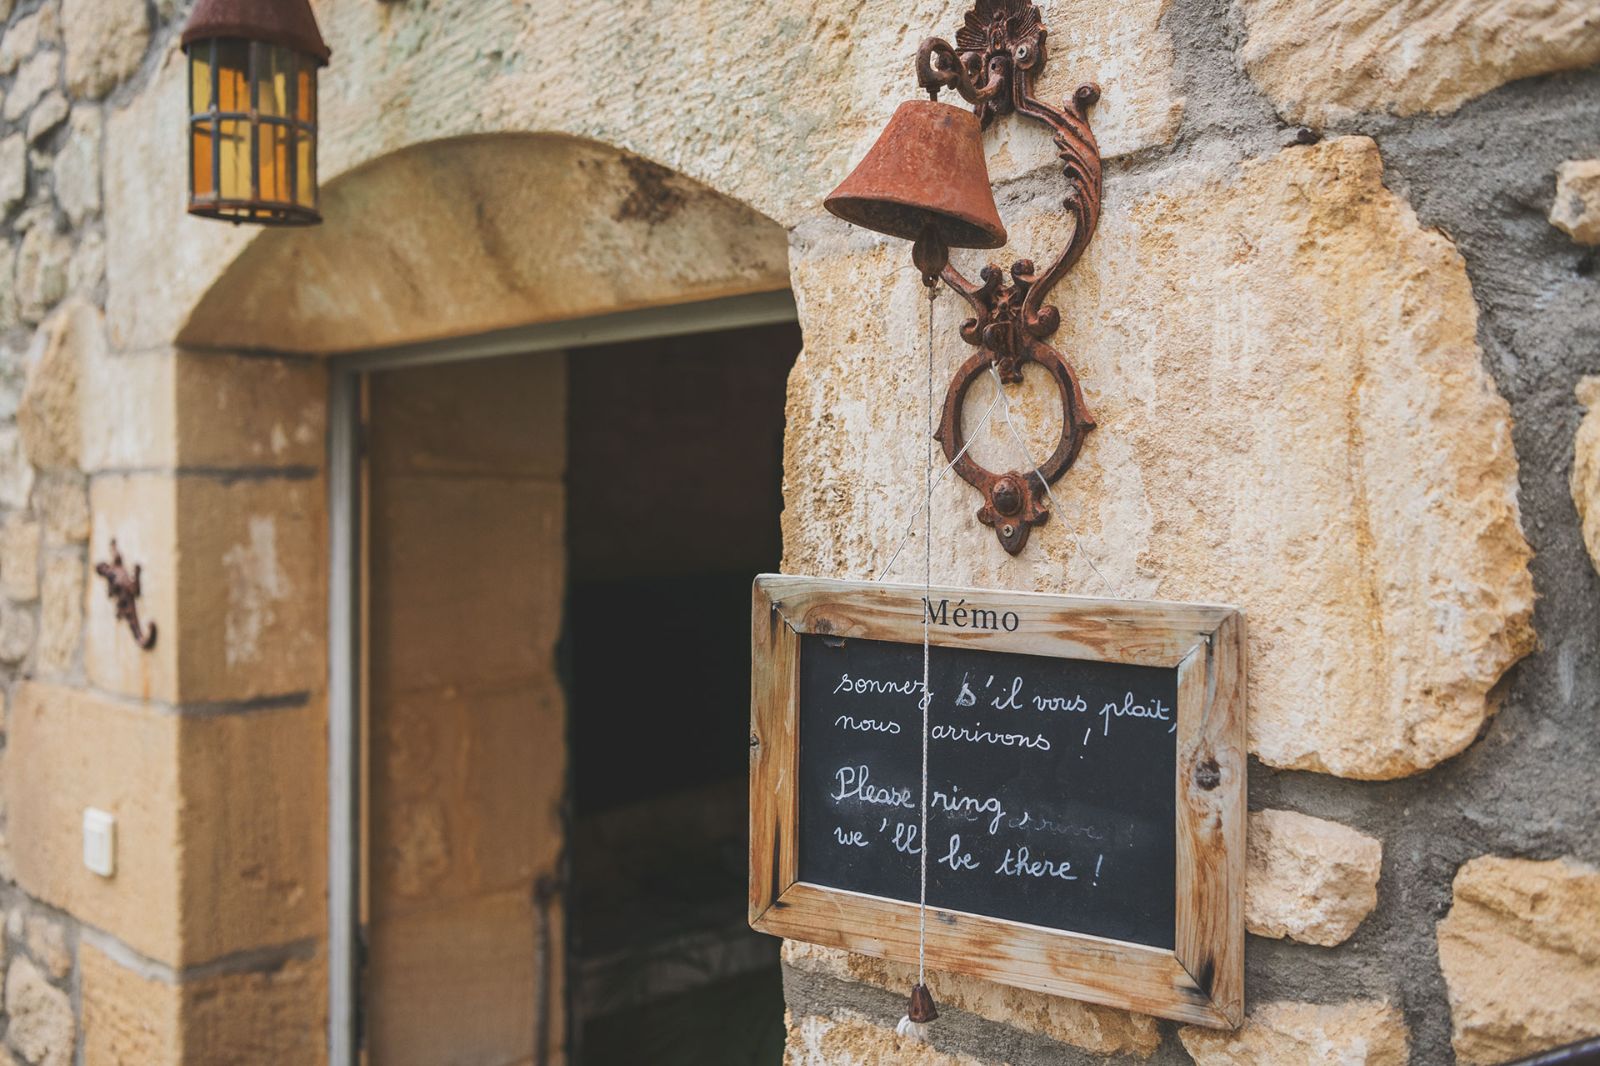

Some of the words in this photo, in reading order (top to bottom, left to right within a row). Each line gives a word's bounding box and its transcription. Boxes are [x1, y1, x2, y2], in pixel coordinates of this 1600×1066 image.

[921, 597, 1019, 632] Mémo
[833, 673, 934, 710] sonnez
[1032, 694, 1088, 712] vous
[834, 714, 901, 734] nous
[931, 722, 1051, 750] arrivons
[830, 765, 916, 809] Please
[938, 833, 981, 871] be
[995, 846, 1078, 880] there
